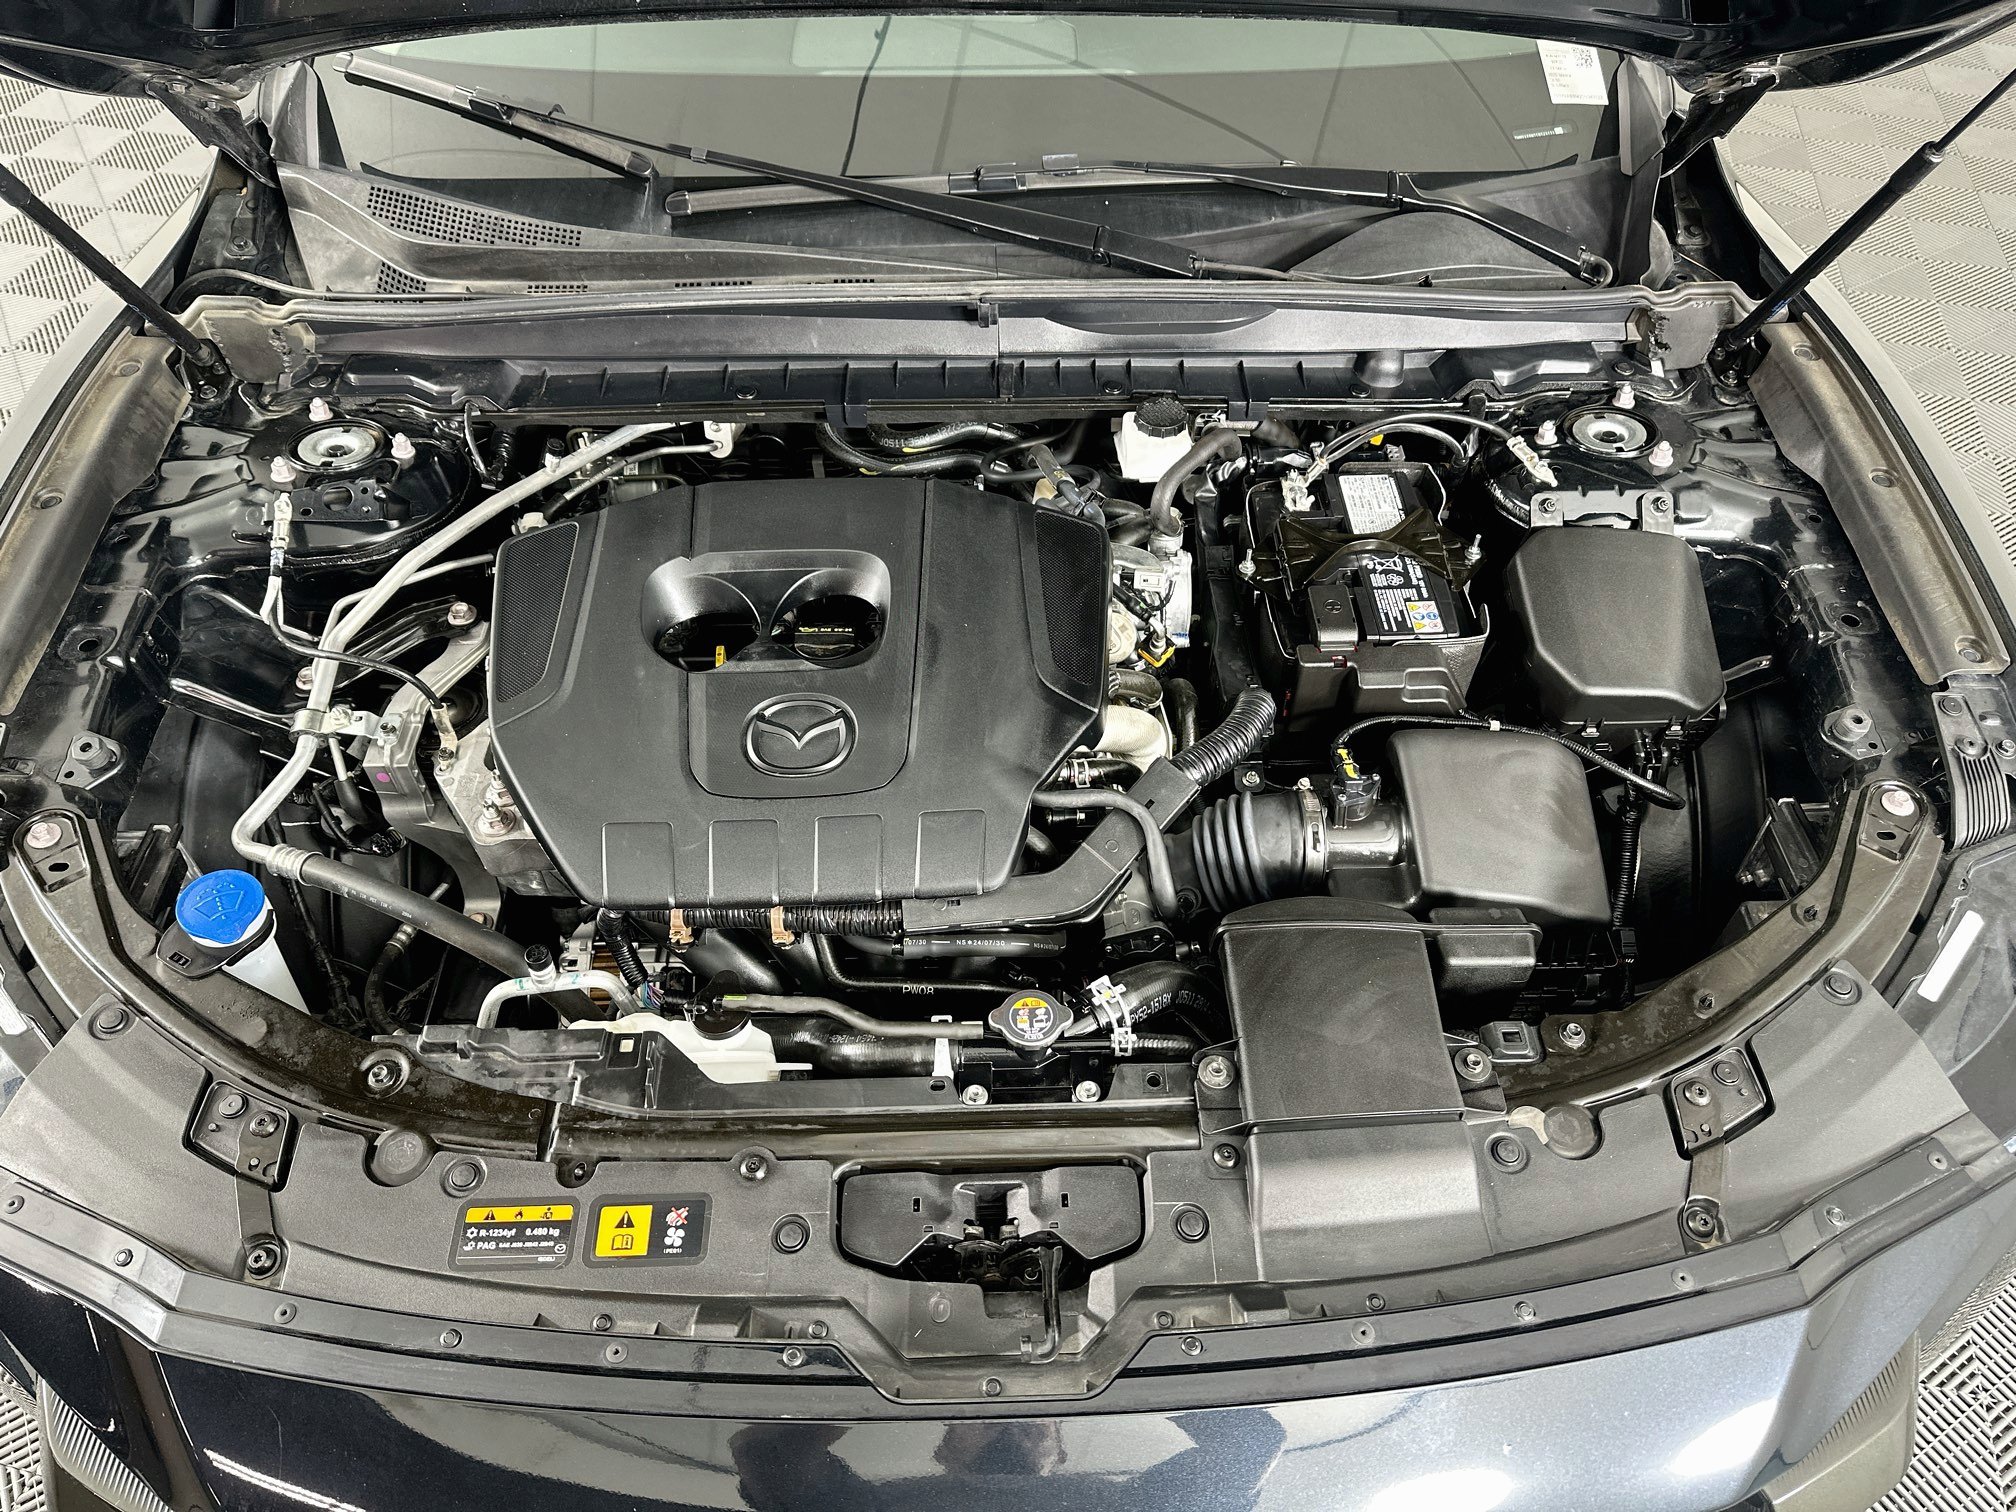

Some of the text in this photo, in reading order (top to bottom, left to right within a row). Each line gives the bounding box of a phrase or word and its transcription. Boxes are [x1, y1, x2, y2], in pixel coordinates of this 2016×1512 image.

[479, 1228, 517, 1239] R-1234yf
[549, 1227, 560, 1238] kg
[476, 1241, 496, 1250] PAG
